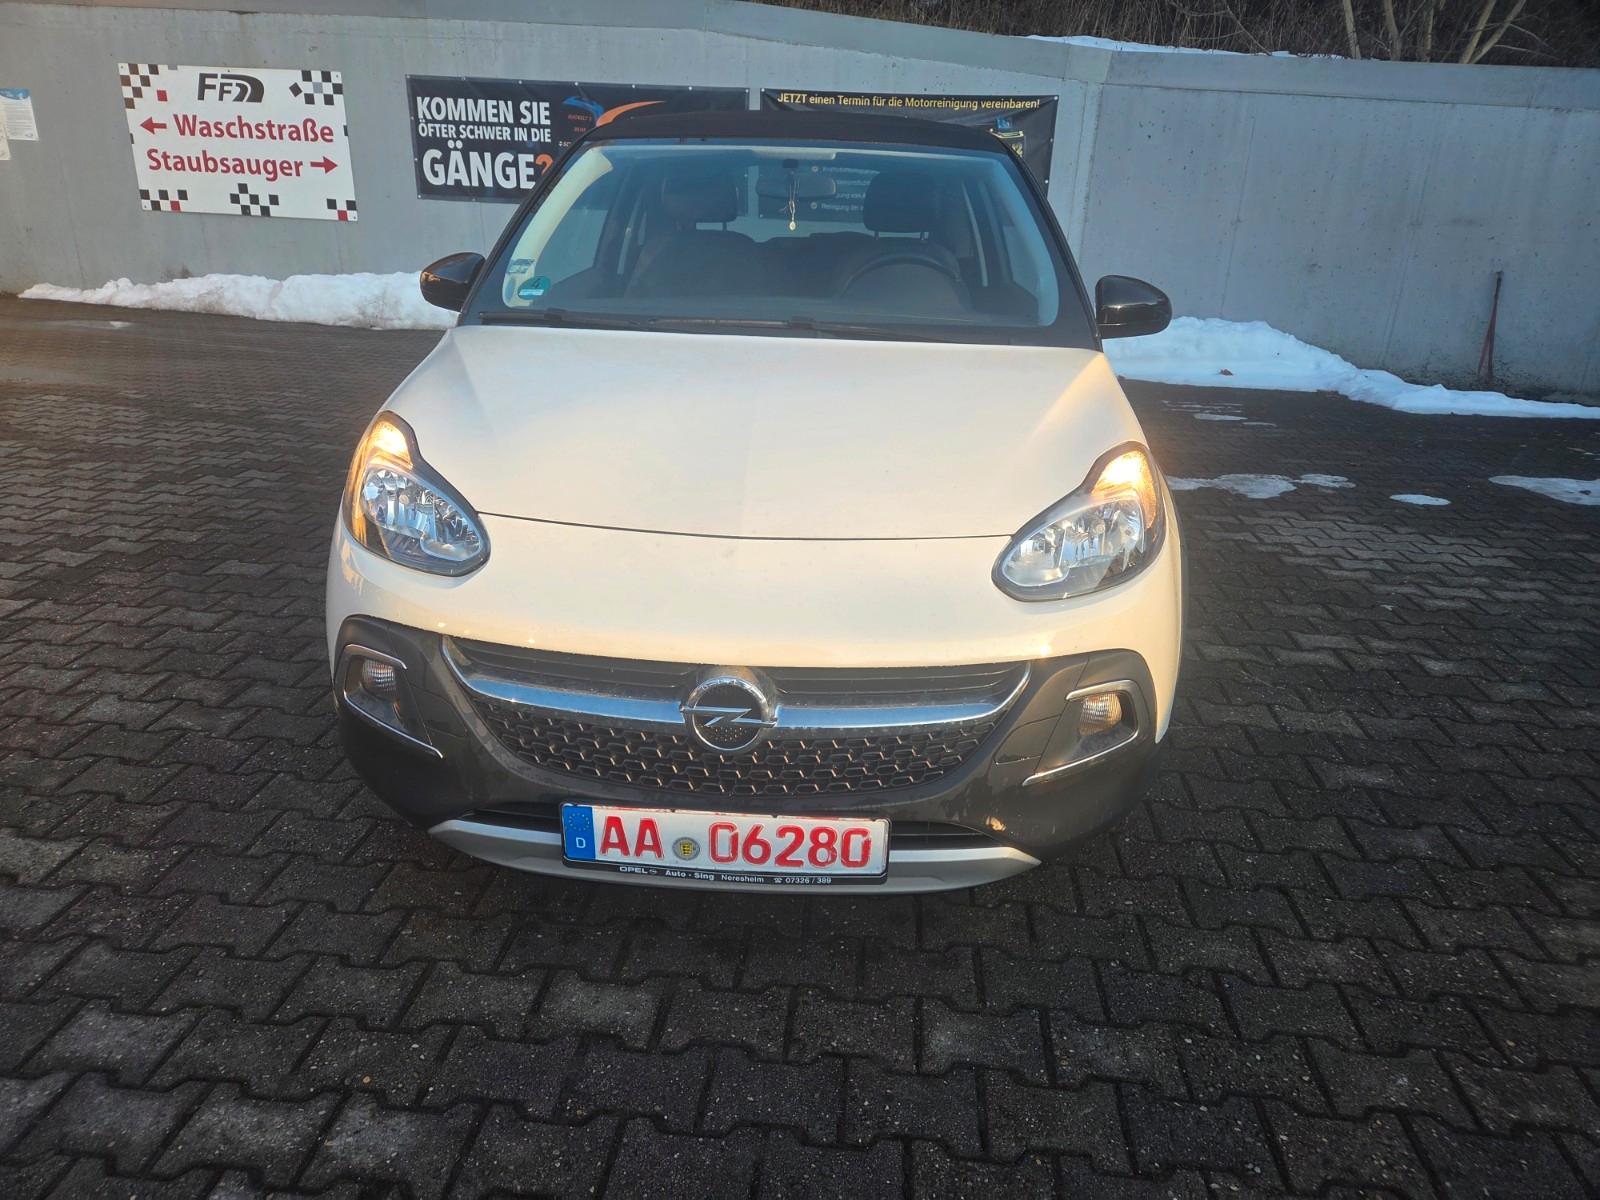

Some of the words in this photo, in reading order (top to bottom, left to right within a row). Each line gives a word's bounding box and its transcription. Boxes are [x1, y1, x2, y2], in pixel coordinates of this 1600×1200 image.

[416, 96, 514, 124] KOMMEN
[519, 100, 551, 125] SIE
[777, 93, 808, 104] JETZT
[809, 94, 835, 105] einen
[838, 95, 871, 106] Termin
[872, 95, 887, 107] für
[888, 96, 903, 107] die
[905, 97, 978, 111] Motorreinigung
[980, 98, 1040, 109] vereinbaren!
[173, 114, 334, 142] Waschstraße
[418, 119, 456, 138] ÖFTER
[459, 124, 511, 140] SCHWER
[514, 127, 528, 142] IN
[531, 128, 551, 142] DIE
[146, 148, 303, 182] Staubsauger
[575, 837, 586, 849] D
[600, 815, 664, 860] AA
[708, 821, 872, 869] 06280
[619, 865, 648, 874] OPEL
[665, 869, 687, 878] Auto
[694, 872, 715, 881] Sing
[721, 874, 764, 883] Neresheim
